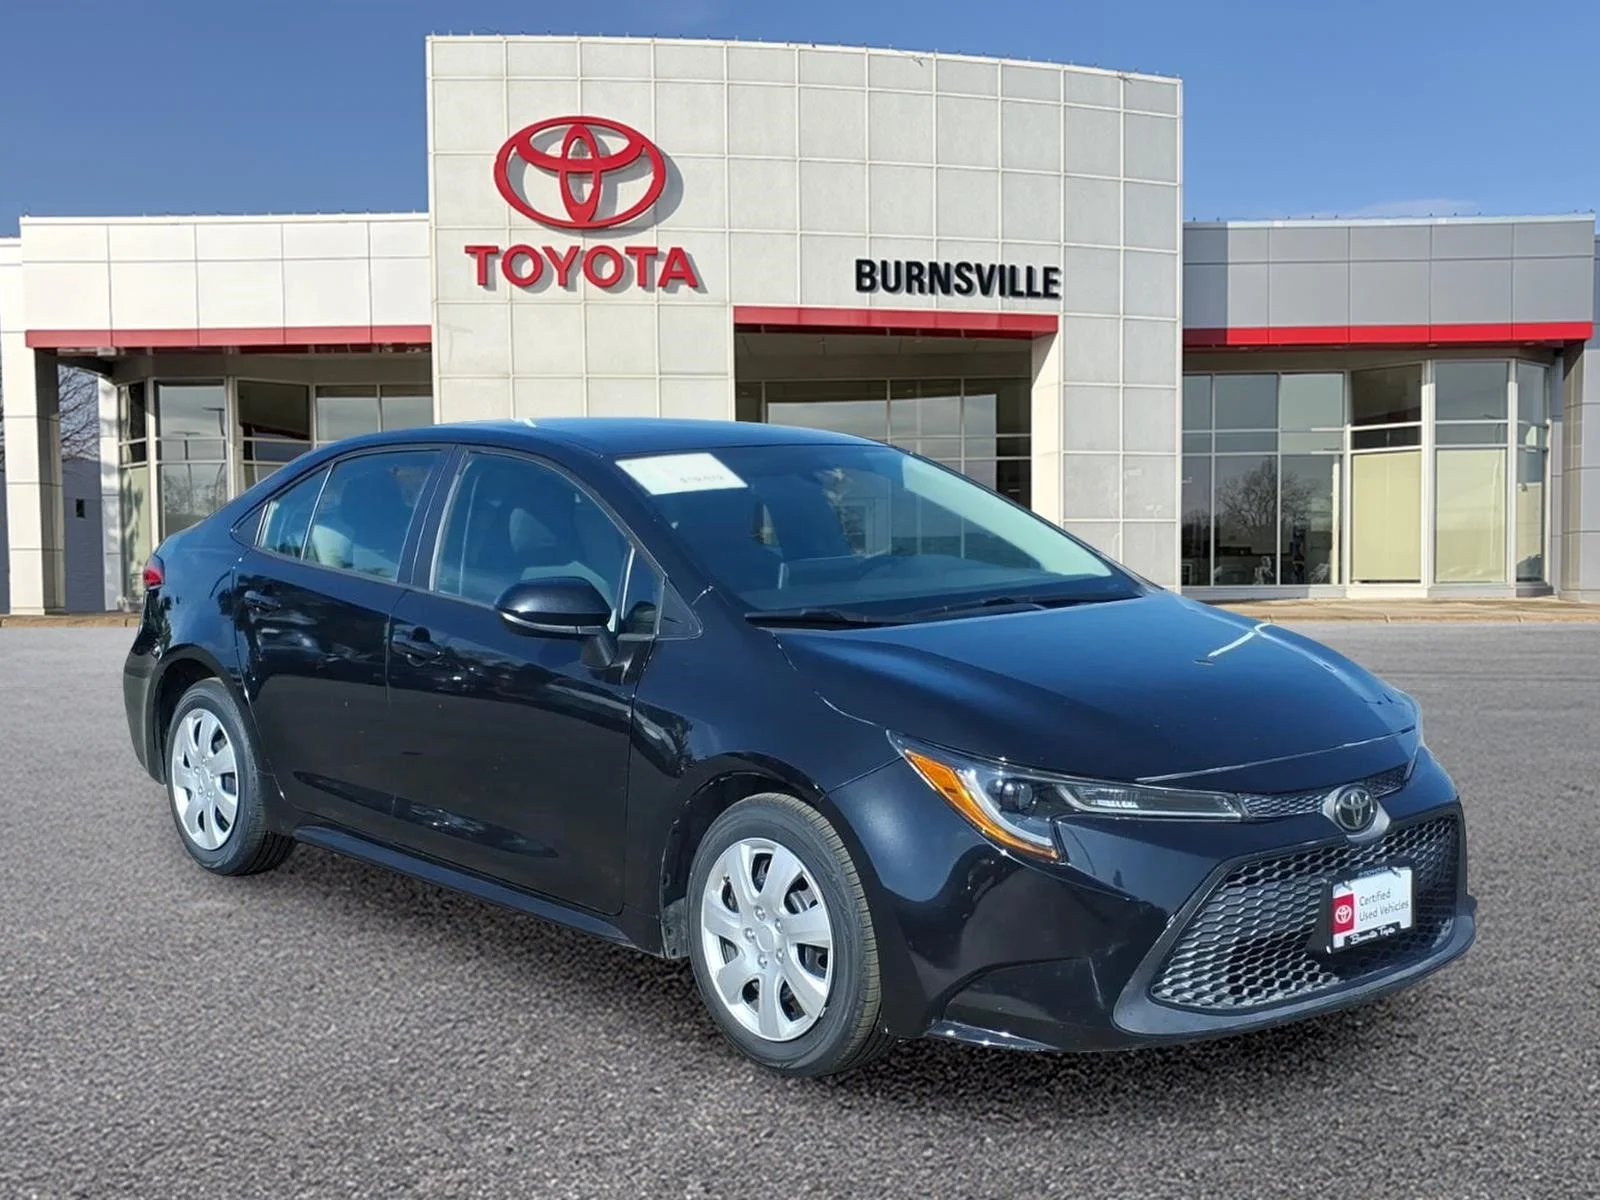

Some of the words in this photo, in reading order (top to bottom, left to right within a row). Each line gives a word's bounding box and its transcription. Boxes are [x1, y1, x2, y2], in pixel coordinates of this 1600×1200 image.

[464, 244, 699, 288] TOYOTA
[855, 259, 1060, 299] BURNSVILLE
[1359, 888, 1391, 906] Certified
[1359, 908, 1378, 922] Used
[1380, 900, 1409, 917] Vehicles
